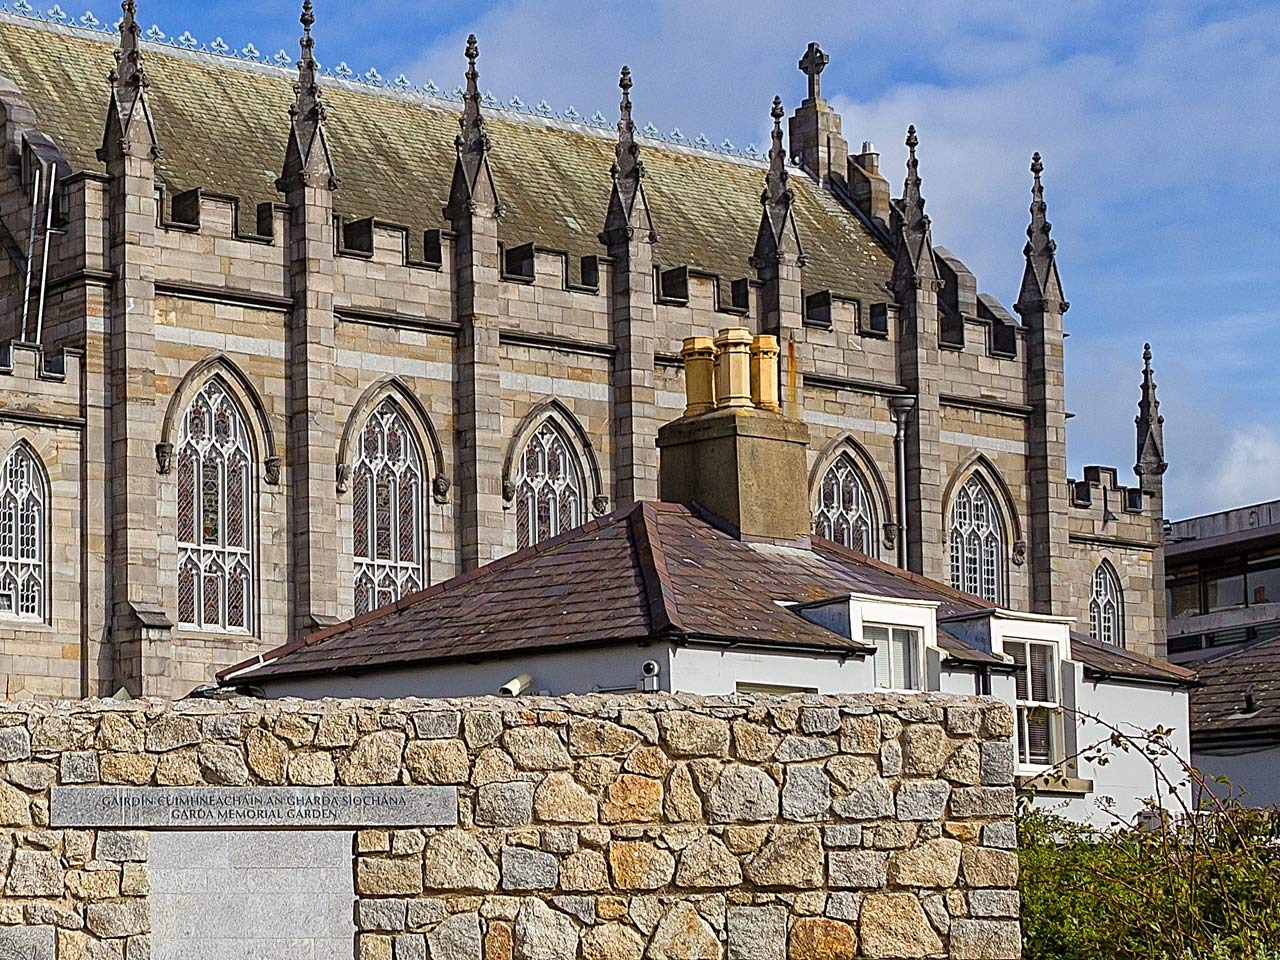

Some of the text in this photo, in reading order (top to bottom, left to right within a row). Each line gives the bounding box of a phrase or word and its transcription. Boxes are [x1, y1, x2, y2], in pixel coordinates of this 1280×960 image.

[267, 796, 283, 806] AN
[286, 795, 339, 806] GHARDA
[171, 809, 338, 819] GARDA MEMORIAL GARDEN
